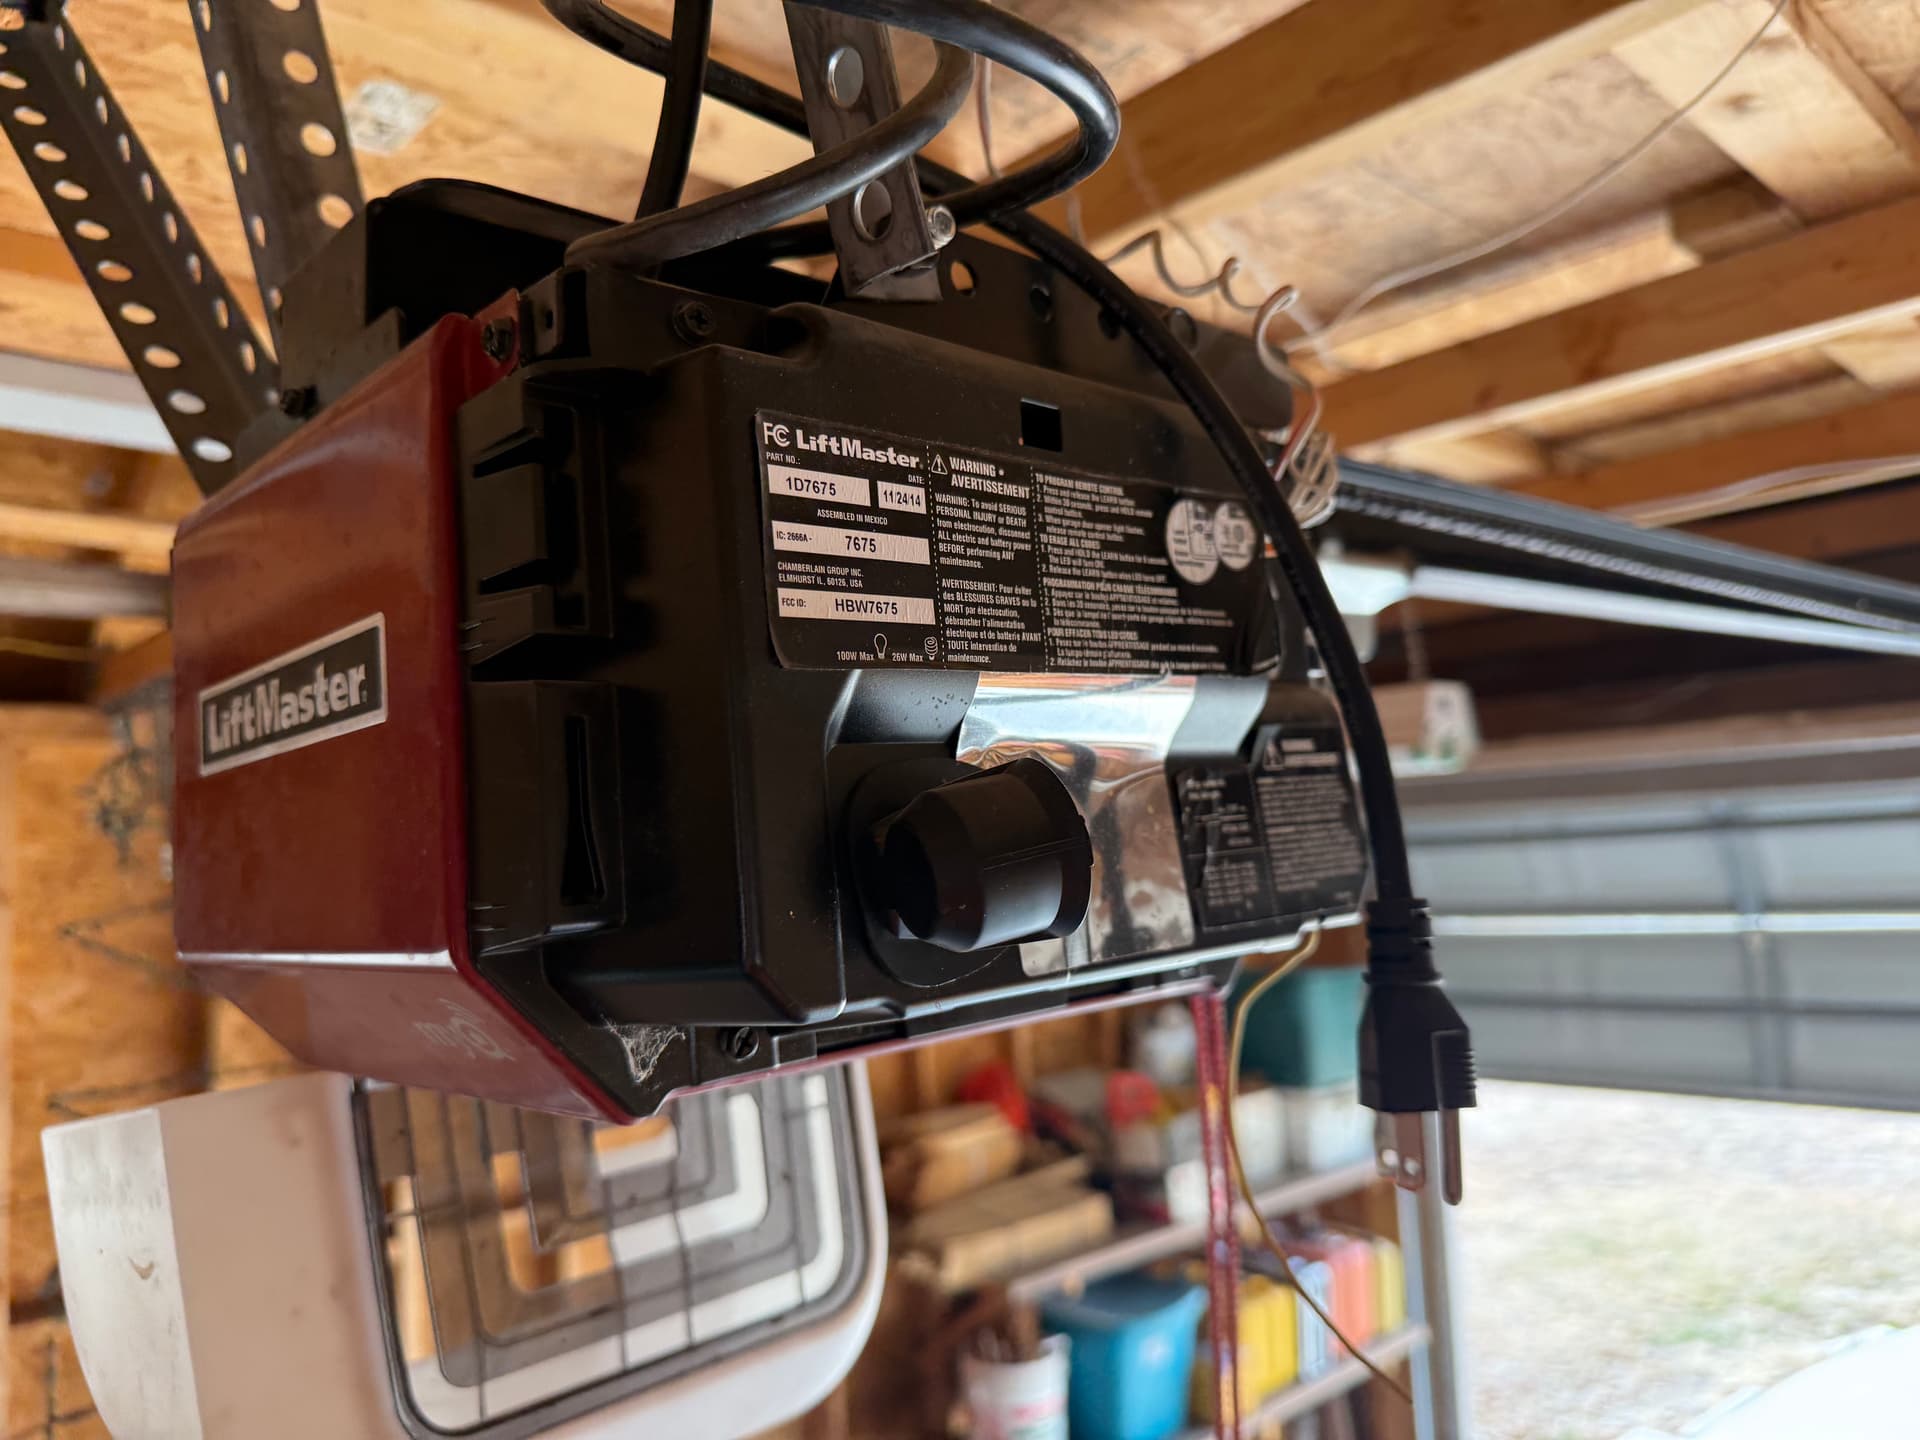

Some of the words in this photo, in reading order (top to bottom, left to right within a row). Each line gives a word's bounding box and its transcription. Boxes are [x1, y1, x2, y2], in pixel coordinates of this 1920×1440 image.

[795, 429, 920, 469] LiftMaster
[766, 452, 783, 462] PART
[785, 453, 801, 465] NO.:
[949, 456, 996, 477] WARNING
[785, 476, 837, 497] 1D7675
[908, 474, 925, 485] DATE:
[951, 474, 1030, 499] AVERTISSEMENT
[883, 490, 921, 507] 11/24/14
[935, 492, 970, 507] WARNING:
[971, 498, 980, 508] To
[981, 499, 998, 511] avoid
[998, 503, 1026, 516] SERIOUS
[817, 509, 855, 522] ASSEMBLED
[856, 513, 864, 523] IN
[864, 514, 888, 526] MEXICO
[936, 505, 972, 519] PERSONAL
[973, 510, 996, 523] INJURY
[997, 515, 1005, 524] or
[1006, 516, 1027, 528] DEATH
[776, 530, 786, 540] IC:
[937, 517, 953, 528] from
[954, 520, 997, 536] electrocution,
[998, 527, 1031, 540] disconnect
[845, 535, 877, 553] 7675
[938, 530, 951, 541] ALL
[952, 532, 976, 544] electric
[977, 535, 989, 546] and
[990, 537, 1012, 549] battery
[1013, 542, 1031, 552] power
[939, 542, 965, 555] BEFORE
[966, 547, 1001, 560] performing
[1002, 551, 1015, 561] ANY
[777, 561, 826, 575] CHAMBERLAIN
[827, 565, 850, 577] GROUP
[850, 567, 864, 577] INC.
[939, 556, 984, 569] maintenance.
[778, 573, 815, 585] ELMHURST
[850, 579, 863, 588] USA
[942, 578, 998, 593] AVERTISSEMENT:
[998, 583, 1013, 594] Pour
[1014, 585, 1032, 596] éviter
[782, 598, 795, 607] FCC
[796, 599, 807, 608] ID:
[835, 598, 898, 615] HBW7675
[943, 591, 955, 601] des
[956, 592, 994, 604] BLESSURES
[995, 596, 1021, 606] GRAVES
[1022, 599, 1030, 607] ou
[1030, 598, 1037, 608] la
[943, 603, 964, 613] MORT
[965, 607, 976, 616] par
[945, 616, 981, 627] débrancher
[946, 628, 979, 640] électrique
[979, 630, 987, 639] et
[987, 630, 996, 640] de
[997, 631, 1021, 641] batterie
[1022, 632, 1042, 642] AVANT
[947, 640, 969, 650] TOUTE
[970, 641, 1008, 652] intervention
[1008, 643, 1017, 653] de
[837, 651, 857, 661] 100W
[859, 651, 875, 661] Max
[892, 652, 907, 662] 26W
[909, 653, 924, 662] Max
[947, 653, 992, 664] maintenance.
[207, 661, 366, 754] LiftMaster
